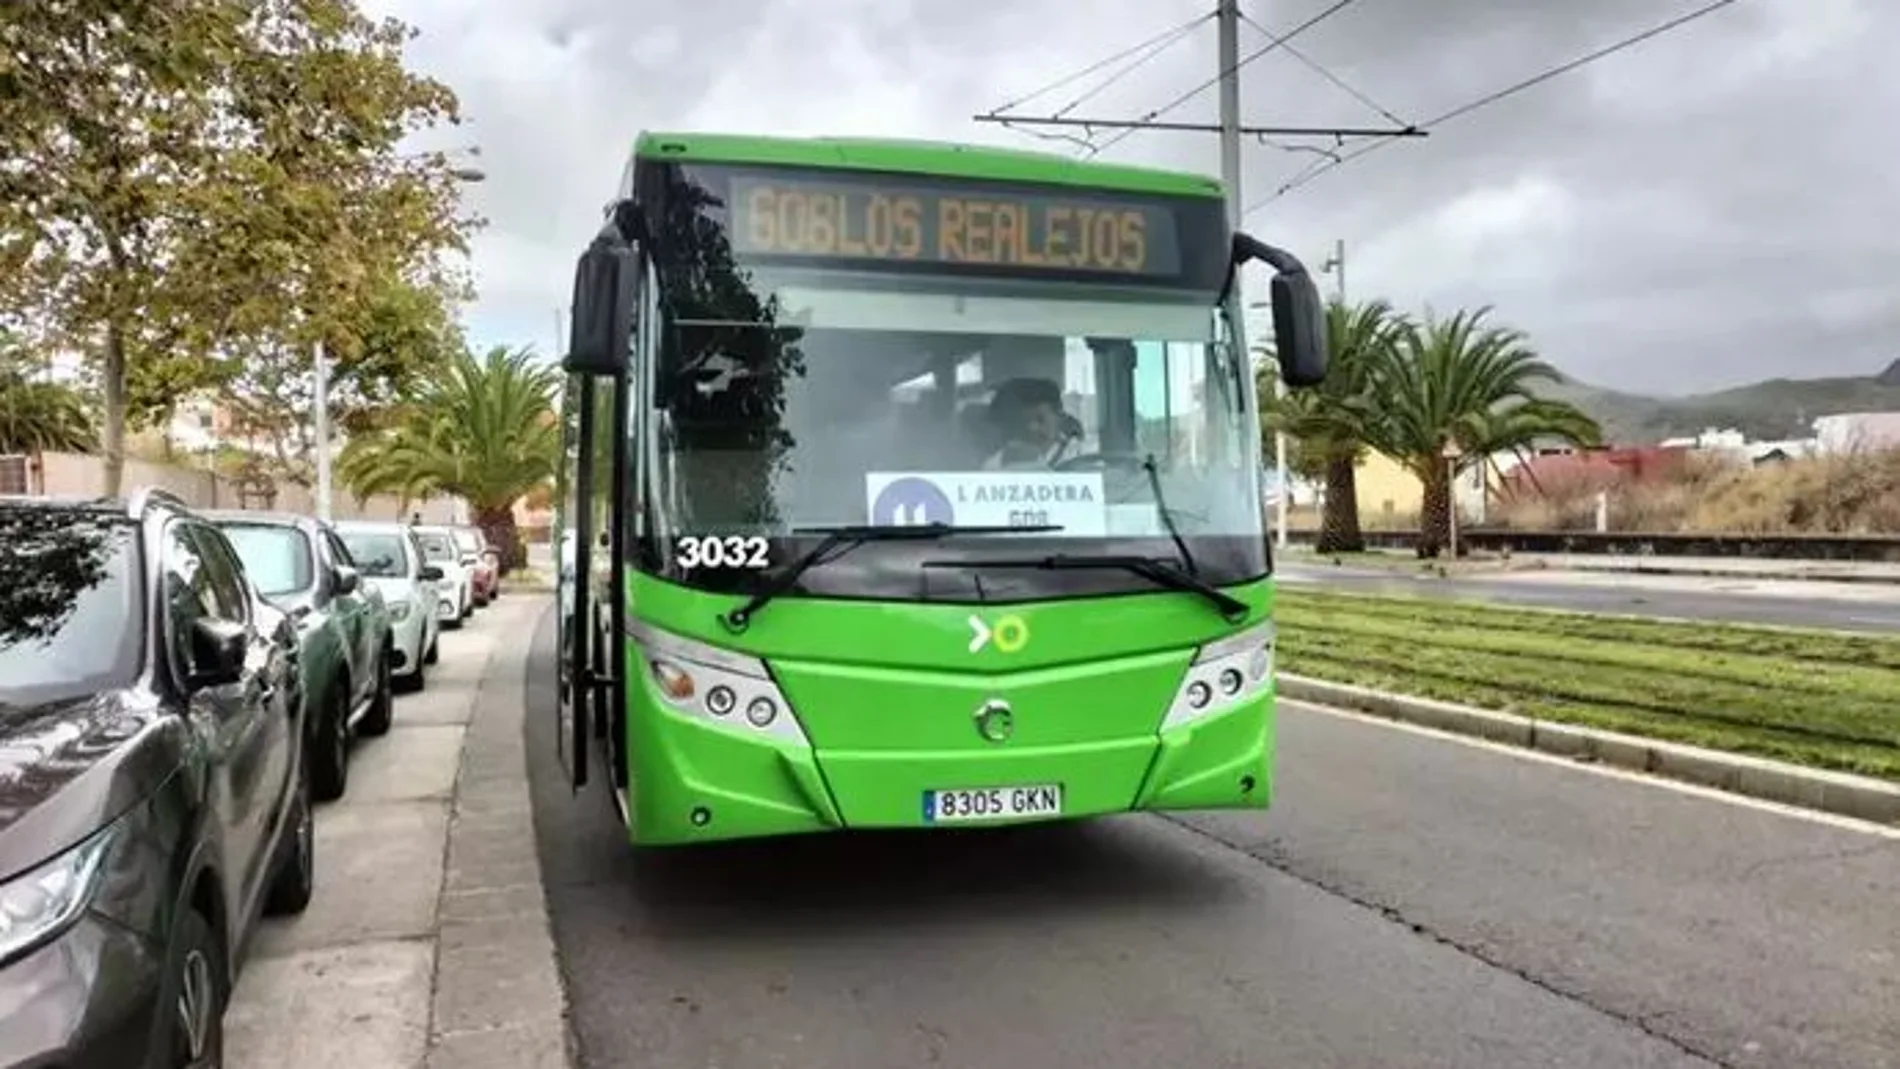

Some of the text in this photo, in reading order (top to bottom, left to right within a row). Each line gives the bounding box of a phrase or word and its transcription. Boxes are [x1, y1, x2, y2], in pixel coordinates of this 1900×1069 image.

[938, 196, 1147, 272] REALEJOS
[677, 536, 769, 568] 3032
[941, 791, 1003, 816] 8305
[1012, 787, 1056, 812] GKN
